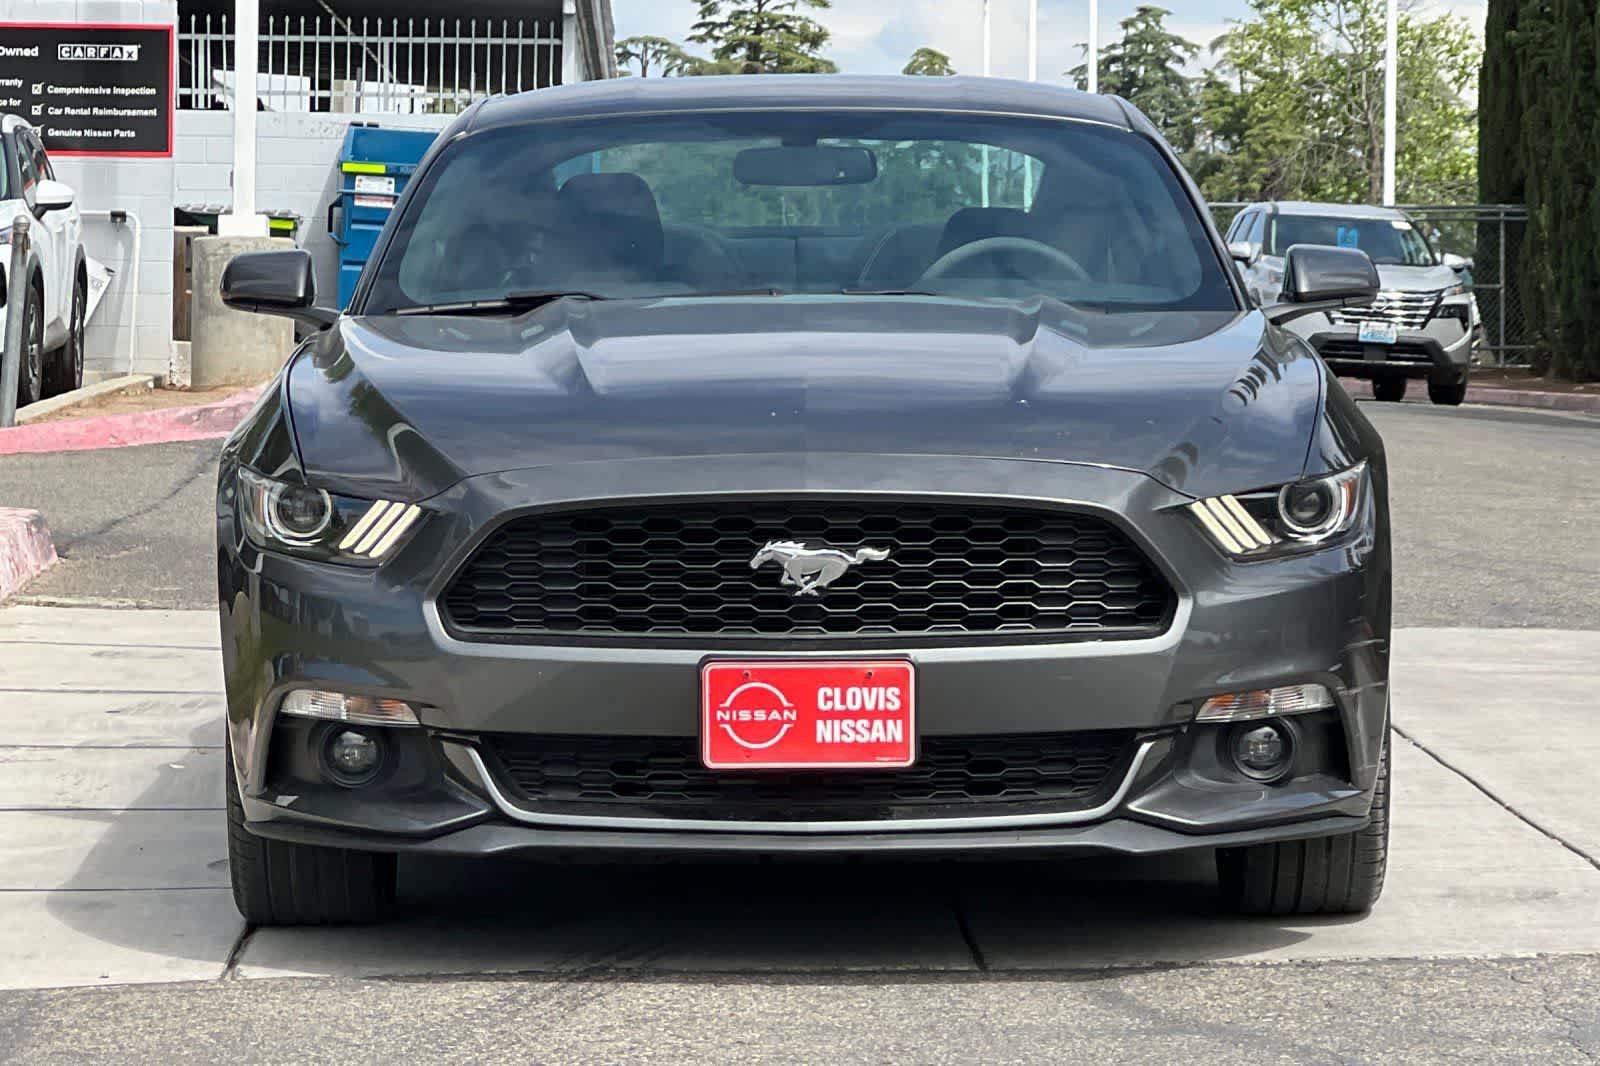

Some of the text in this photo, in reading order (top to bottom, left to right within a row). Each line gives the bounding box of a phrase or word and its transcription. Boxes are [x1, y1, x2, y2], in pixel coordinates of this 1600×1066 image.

[0, 46, 39, 57] Owned
[58, 44, 138, 60] CARFAX
[47, 86, 156, 96] Comprehensive Inspection
[9, 97, 22, 106] for
[47, 107, 157, 116] Car Rental Reimbursement
[47, 128, 136, 137] Genuine Nissan Parts
[817, 687, 901, 711] CLOVIS
[716, 709, 797, 721] NISSAN
[815, 719, 903, 744] NISSAN
